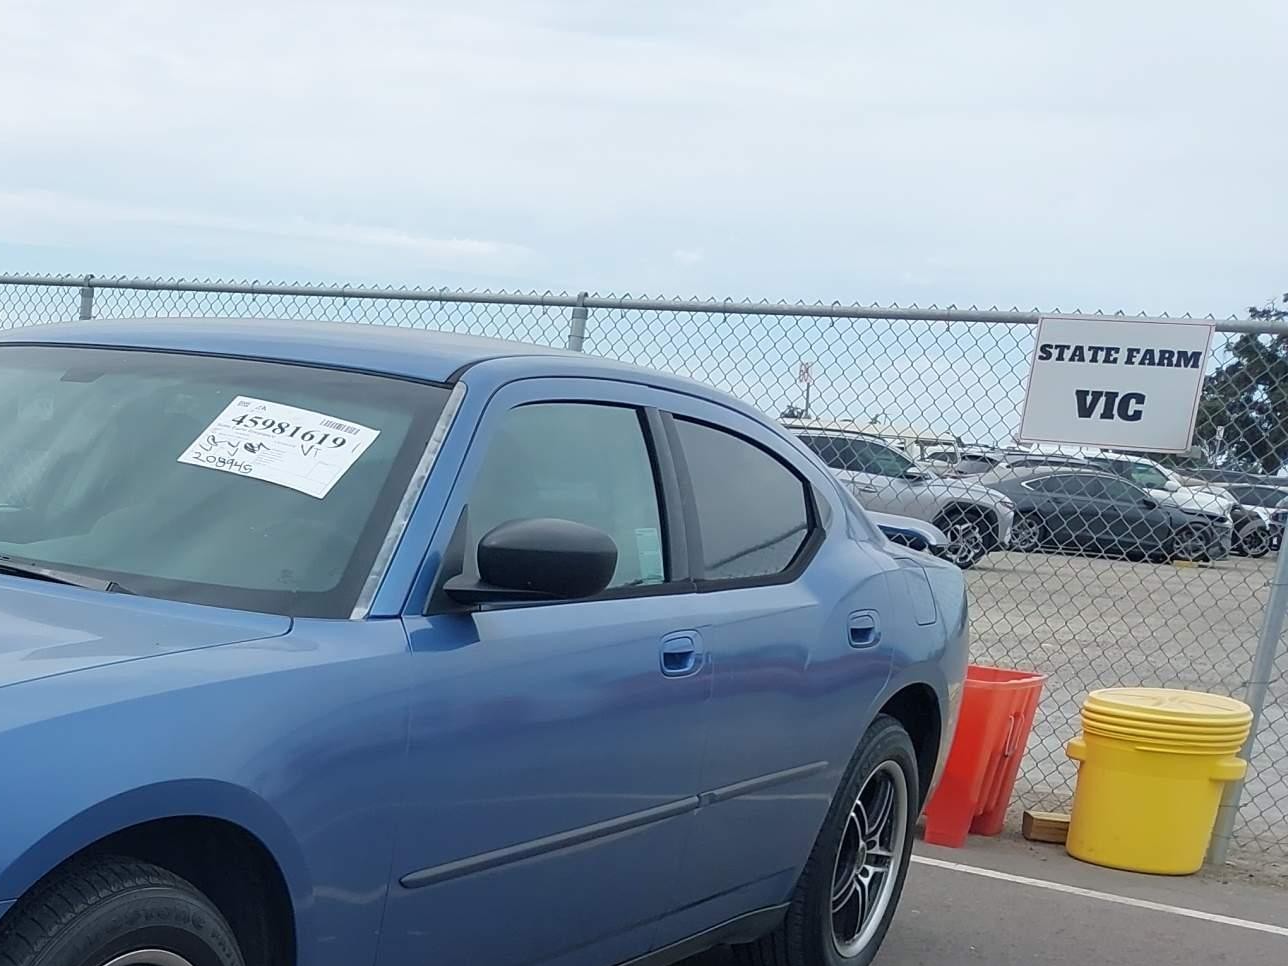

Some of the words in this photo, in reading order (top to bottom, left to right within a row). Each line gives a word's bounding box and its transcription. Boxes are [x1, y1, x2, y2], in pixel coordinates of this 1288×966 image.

[1038, 344, 1121, 365] STATE
[1124, 347, 1203, 369] FARM
[1074, 389, 1147, 422] VIC
[232, 413, 347, 450] 45981619
